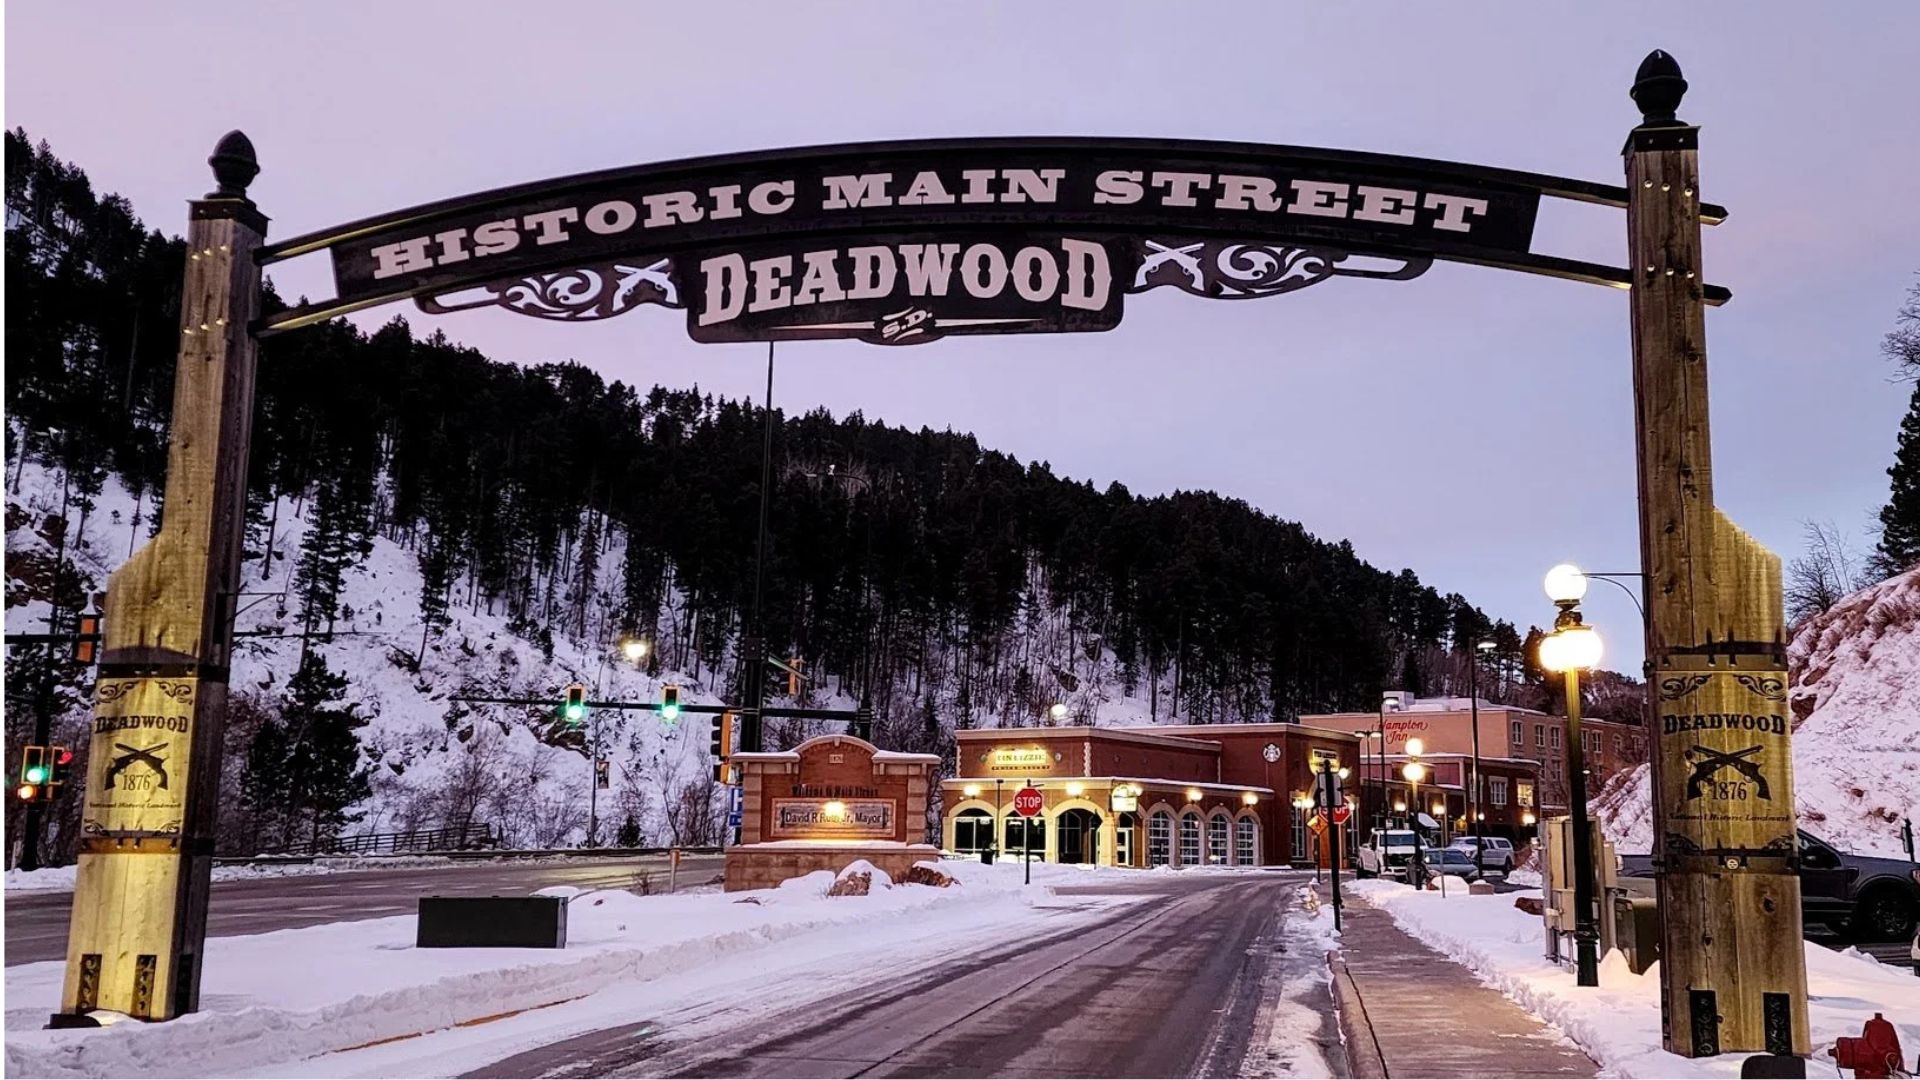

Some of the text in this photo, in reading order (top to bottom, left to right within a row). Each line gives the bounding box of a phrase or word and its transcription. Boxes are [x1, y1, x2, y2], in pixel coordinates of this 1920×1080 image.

[371, 168, 1488, 280] HISTORIC MAIN STREET
[699, 237, 1111, 327] DEADWOOD
[882, 310, 933, 338] S.D.
[94, 715, 188, 734] DEADWOOD
[1663, 714, 1786, 735] DEADWOOD
[1385, 730, 1408, 745] Inn
[122, 775, 151, 791] 1876
[1711, 782, 1747, 801] 1876
[1016, 796, 1041, 808] STOP
[785, 812, 810, 823] David
[855, 812, 882, 825] Mayor
